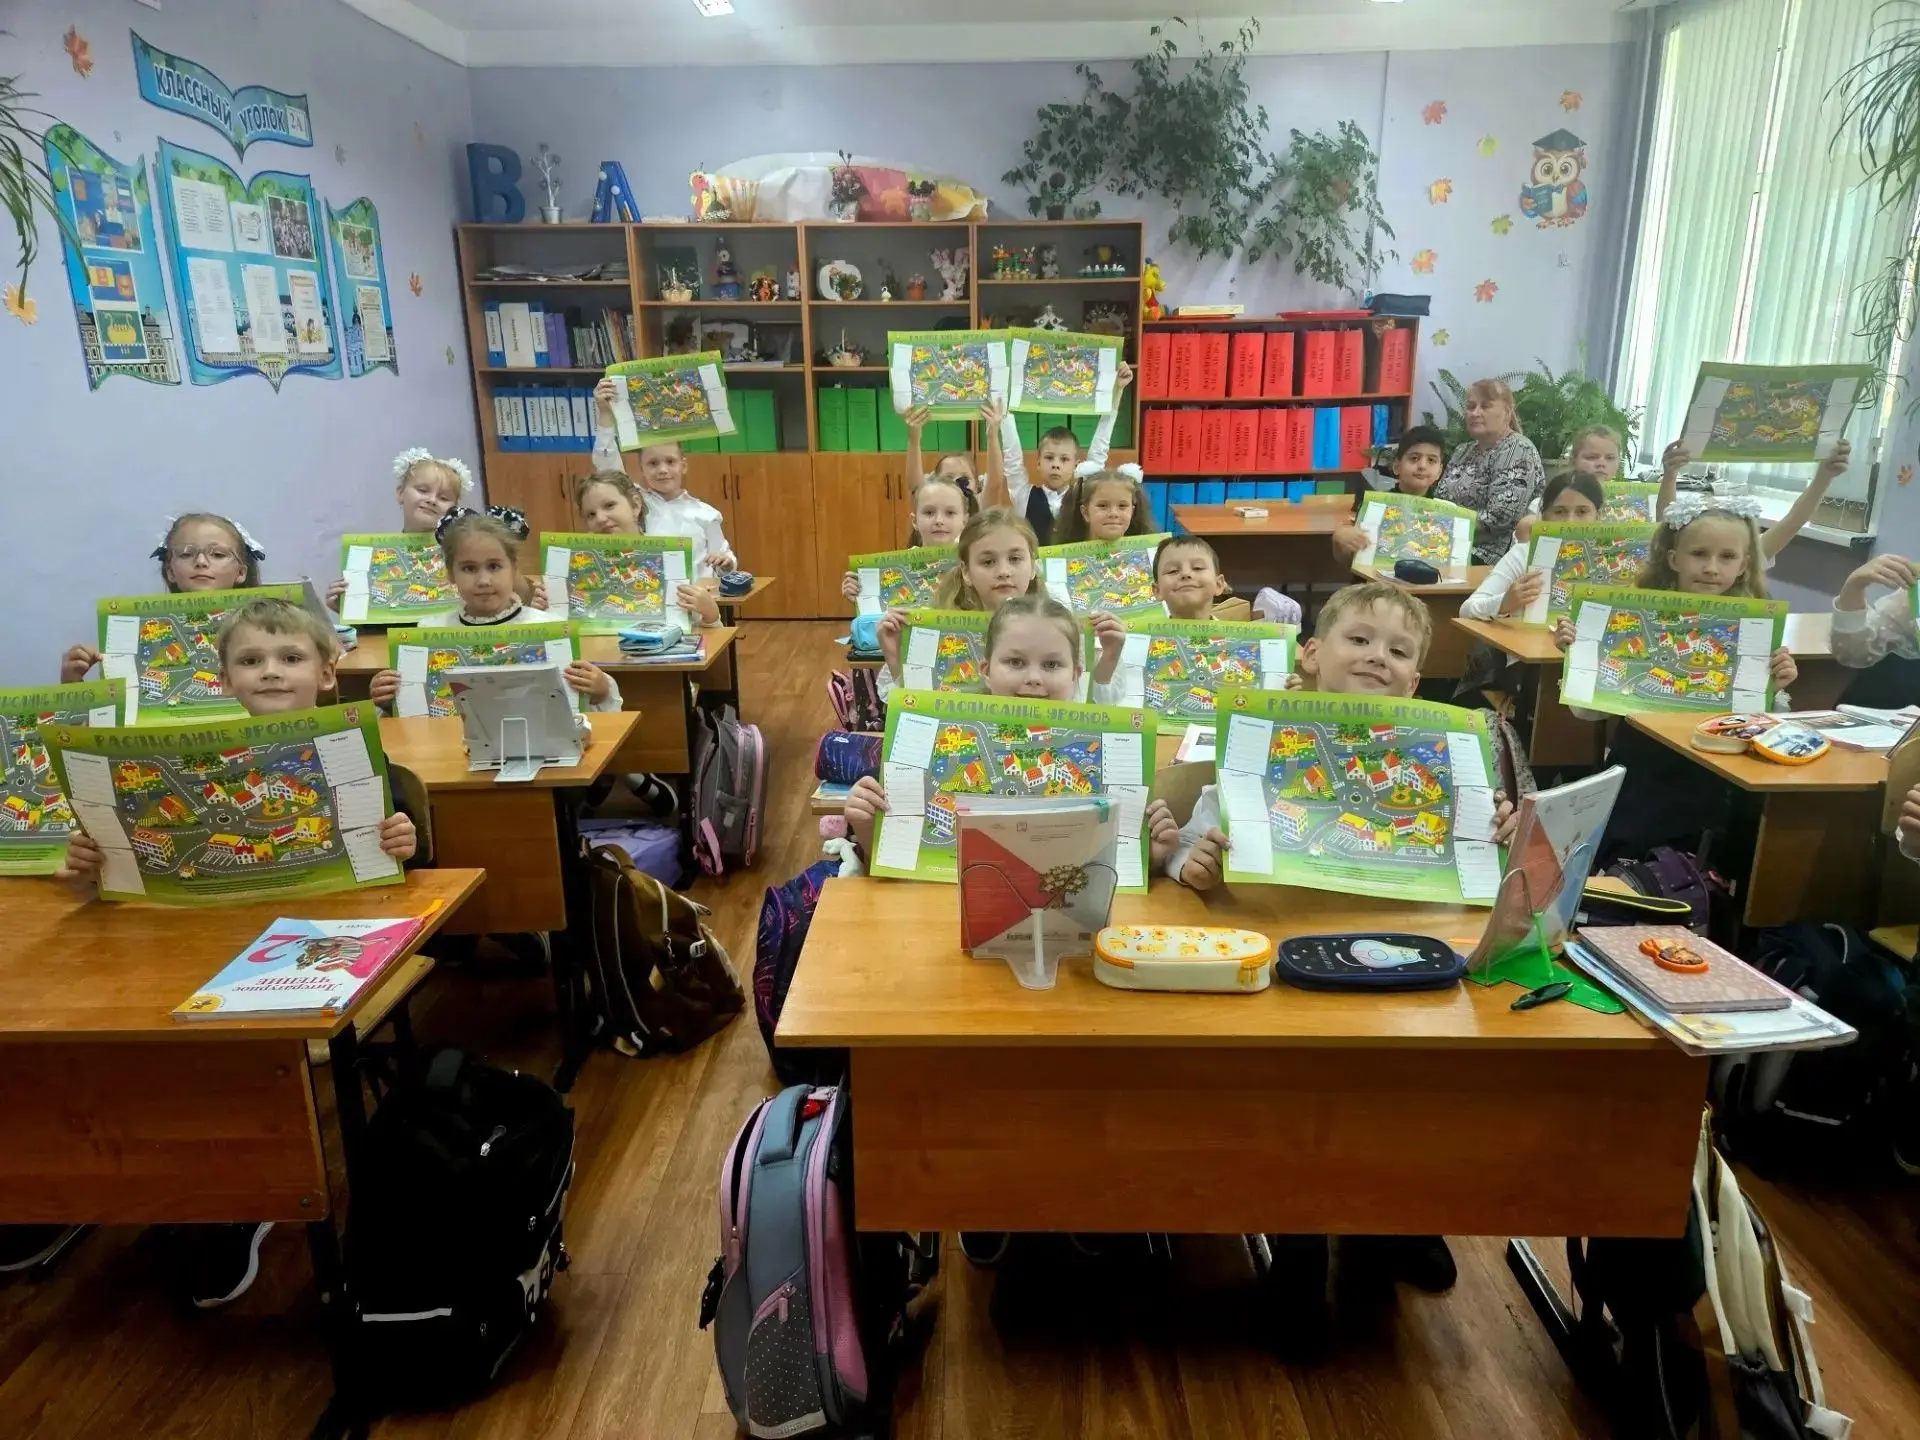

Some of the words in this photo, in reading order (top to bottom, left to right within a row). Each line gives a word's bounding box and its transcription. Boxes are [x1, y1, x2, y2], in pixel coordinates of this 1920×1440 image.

[154, 65, 234, 133] КЛАССНЫЙ
[238, 104, 287, 133] УГОЛОК
[933, 698, 1041, 720] РАСПИСАНИЕ
[1046, 708, 1111, 725] УРОКОВ
[1266, 698, 1385, 718] РАСПИСАНИЕ
[1389, 706, 1451, 724] УРОКОВ
[94, 728, 233, 750] РАСПИСАНИЕ
[238, 716, 320, 741] УРОКОВ
[247, 934, 310, 963] 2
[232, 982, 342, 992] Литературное
[255, 976, 331, 985] ЧТЕНИЕ
